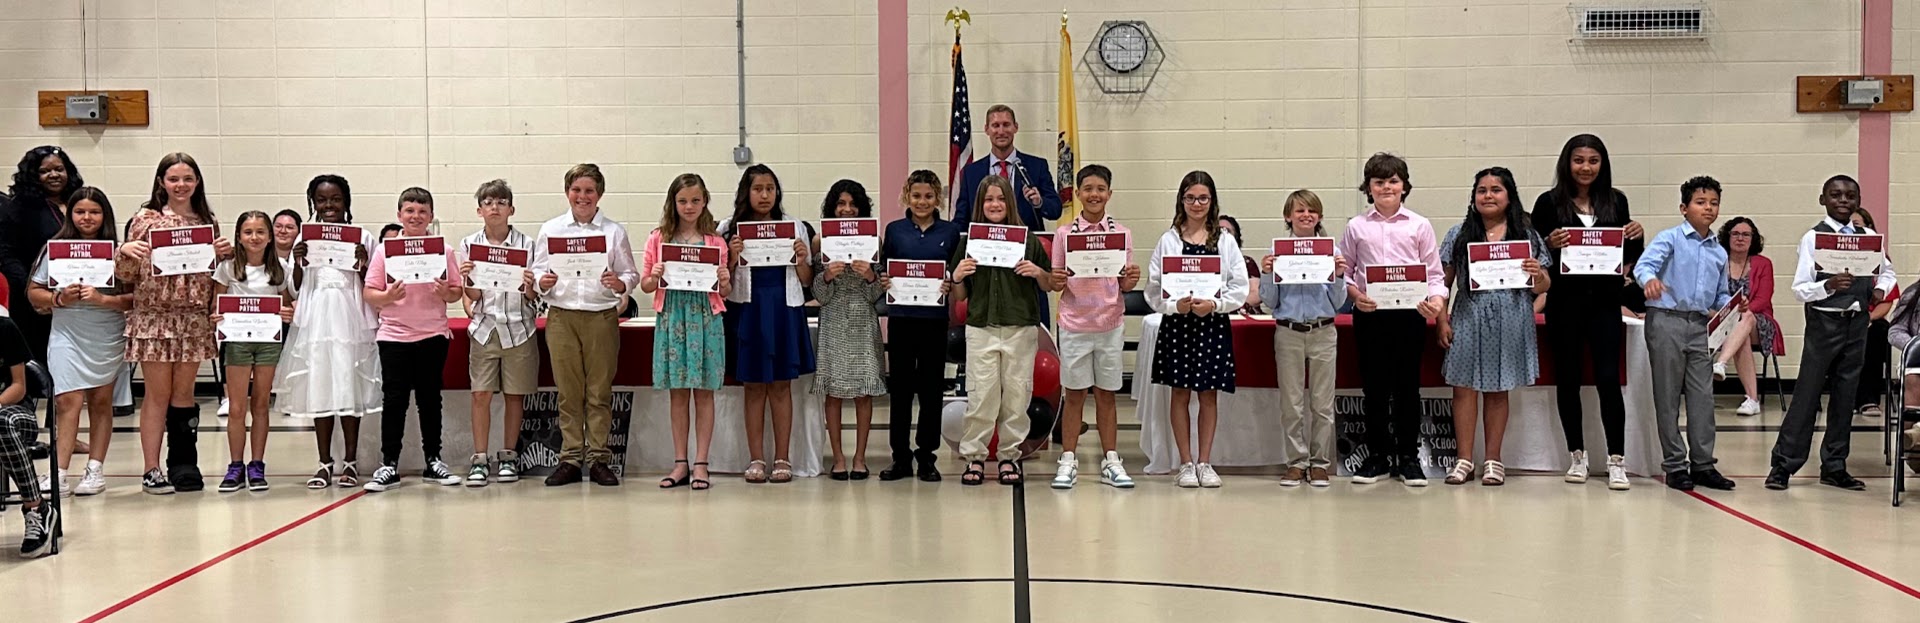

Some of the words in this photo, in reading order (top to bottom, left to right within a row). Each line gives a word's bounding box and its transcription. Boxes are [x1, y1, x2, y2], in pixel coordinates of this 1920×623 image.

[520, 418, 540, 430] 2023
[1343, 421, 1366, 434] 2023
[1430, 438, 1457, 450] SCHOO
